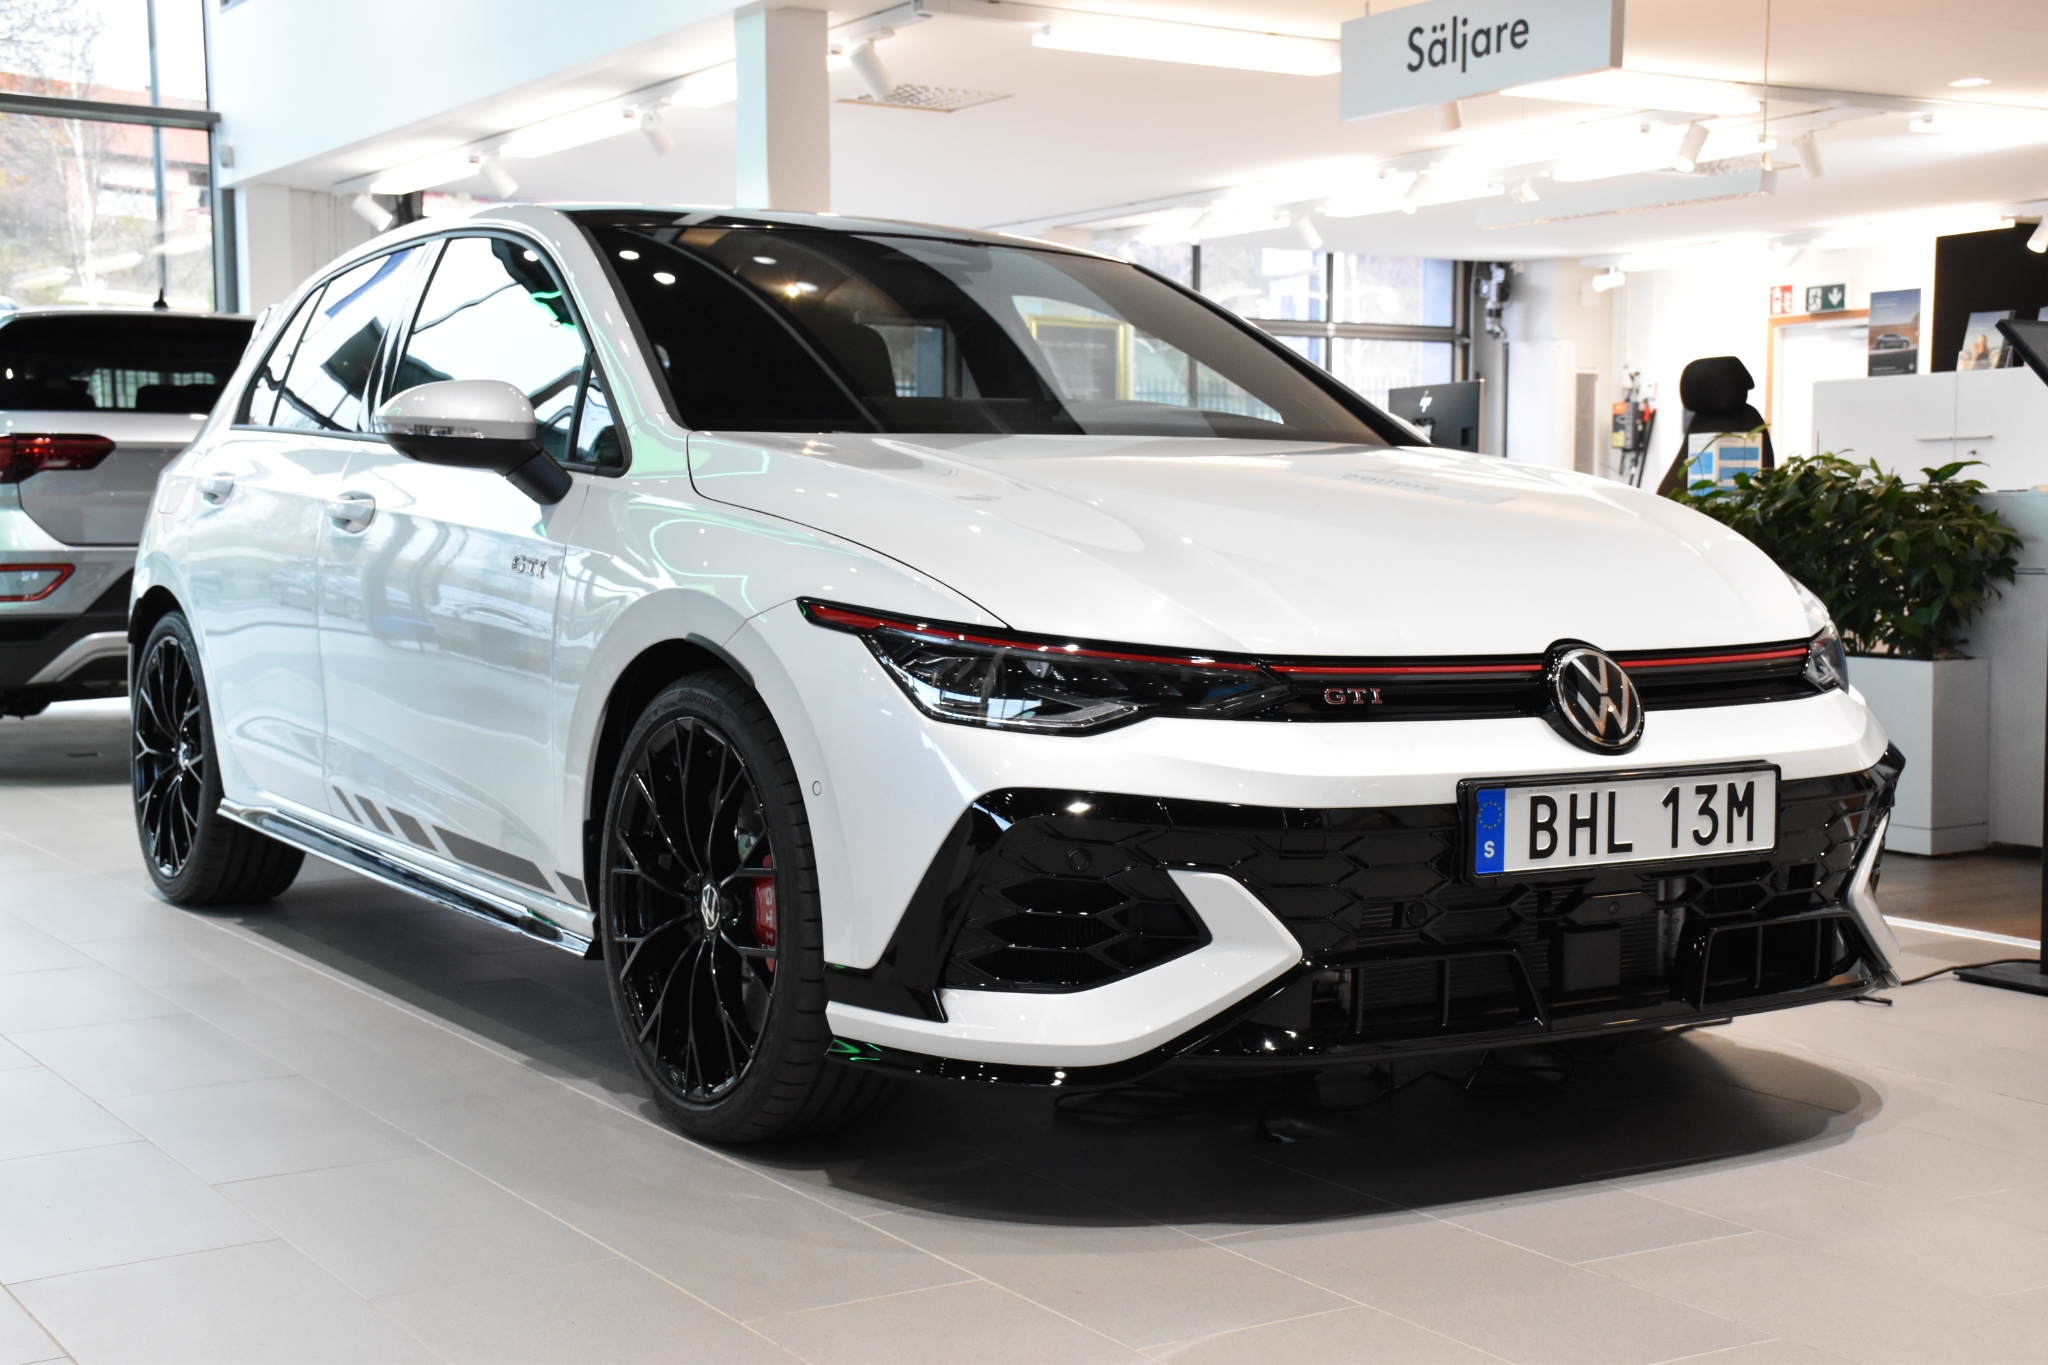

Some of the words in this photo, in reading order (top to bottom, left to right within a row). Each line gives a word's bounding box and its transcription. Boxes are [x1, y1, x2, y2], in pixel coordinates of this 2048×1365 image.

[1406, 15, 1530, 73] Säljare
[511, 554, 547, 579] GTI
[1324, 686, 1383, 705] GTI
[1529, 791, 1633, 860] BHL
[1662, 780, 1755, 849] 13M
[1484, 840, 1495, 858] S
[765, 886, 774, 943] GTI
